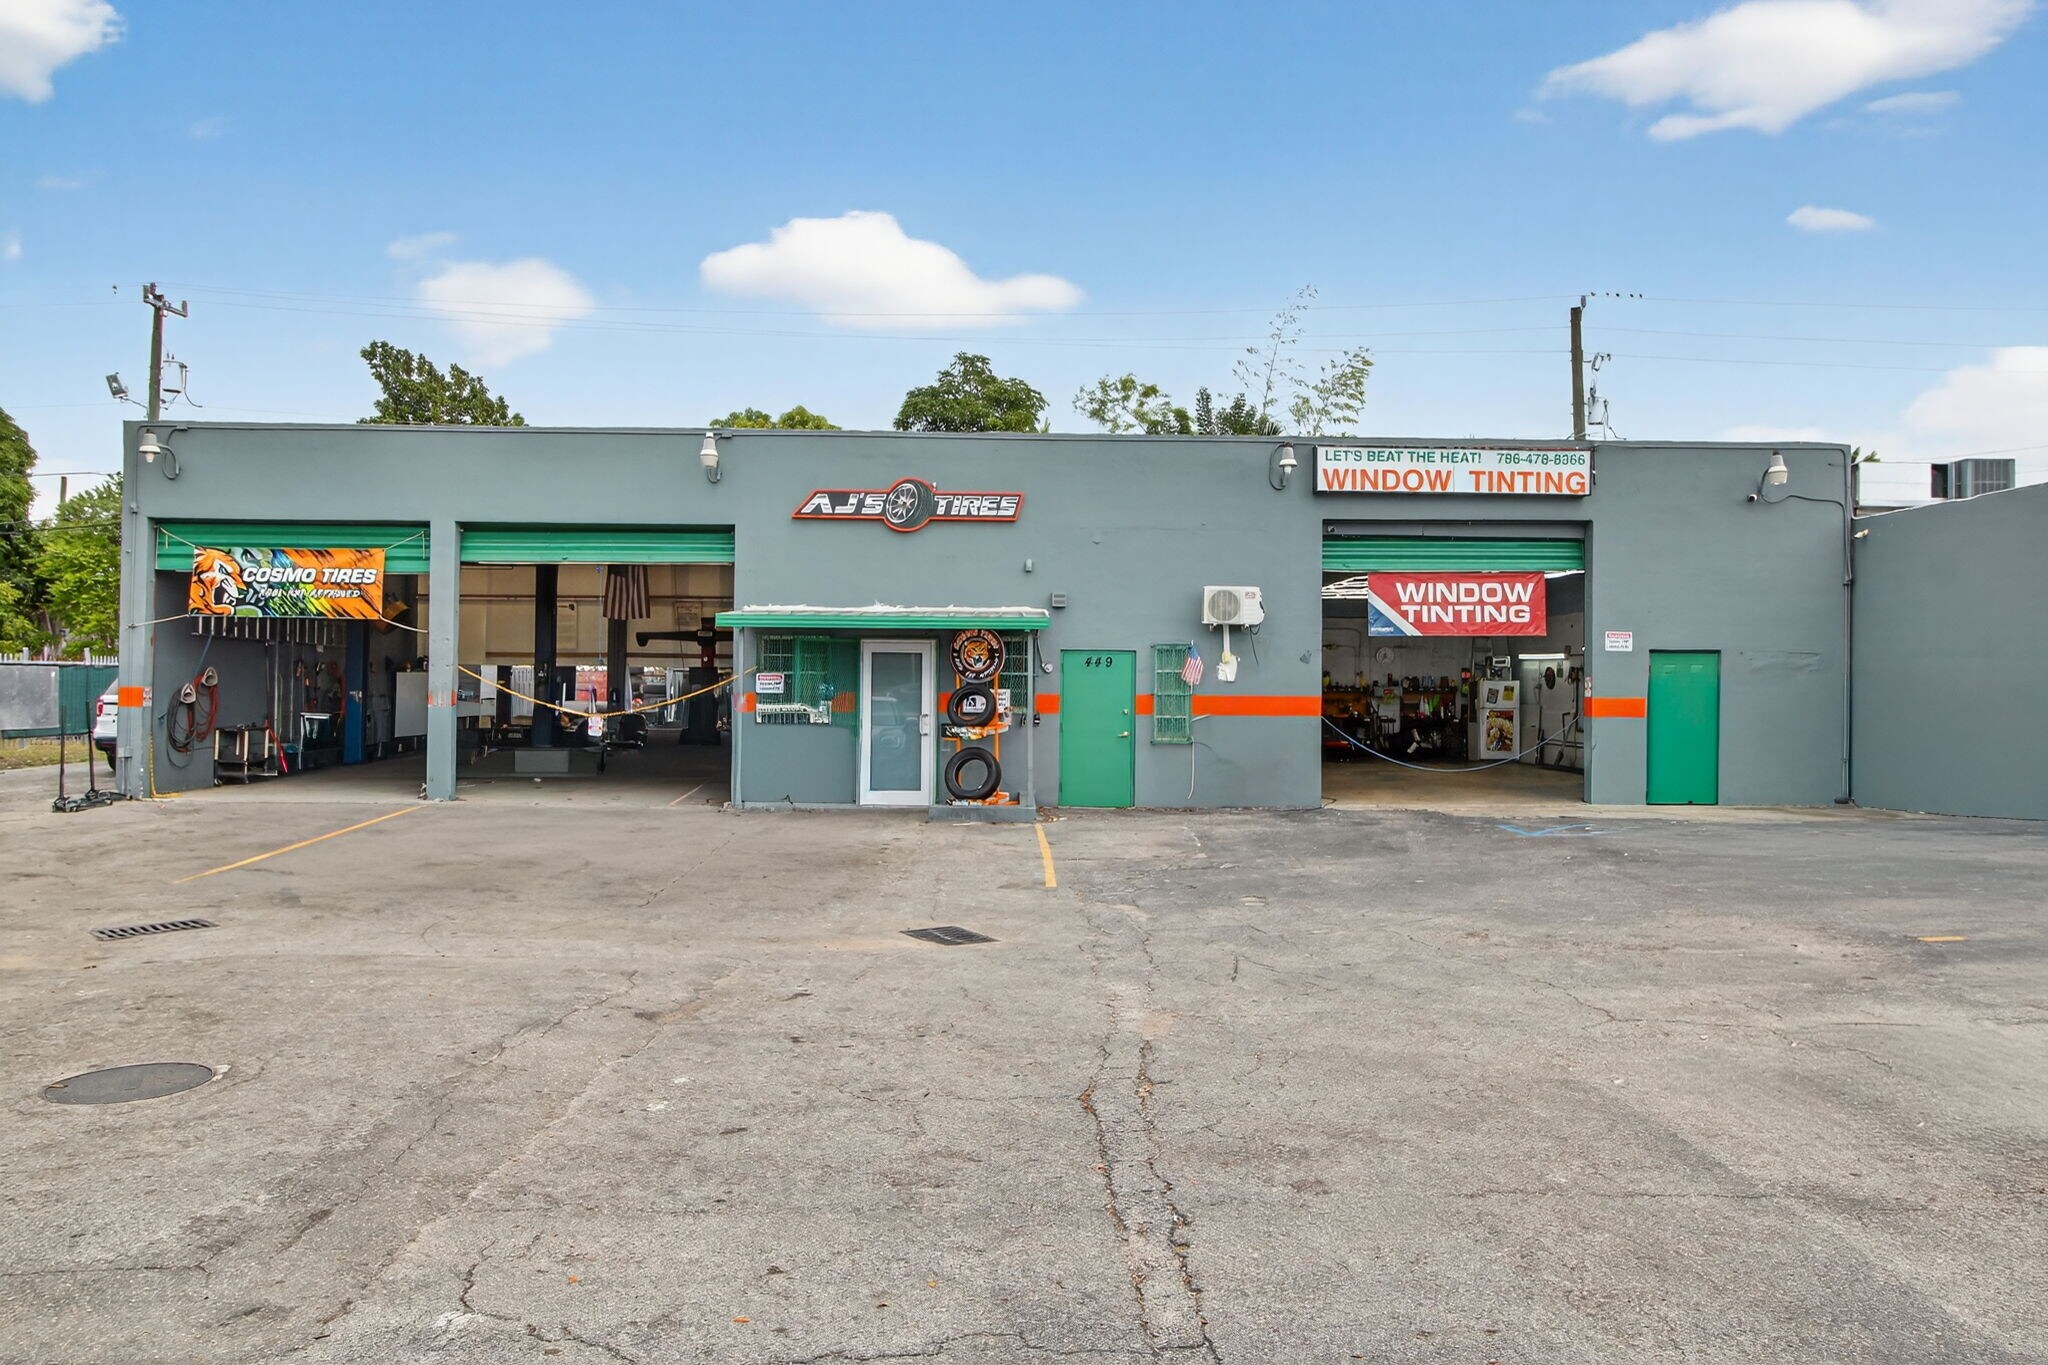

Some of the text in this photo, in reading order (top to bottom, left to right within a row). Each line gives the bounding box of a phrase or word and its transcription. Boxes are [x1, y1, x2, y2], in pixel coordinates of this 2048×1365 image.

[1325, 450, 1362, 462] LET'S
[1367, 451, 1404, 463] BEAT
[1407, 452, 1436, 463] THE
[1440, 452, 1482, 464] HEAT!
[1322, 468, 1586, 494] WINDOW TINTING
[801, 493, 1020, 516] AJ'S TIRES
[242, 567, 377, 584] COSMO TIRES
[1395, 582, 1534, 603] WINDOW
[1400, 605, 1531, 623] TINTING
[1085, 656, 1113, 668] 449
